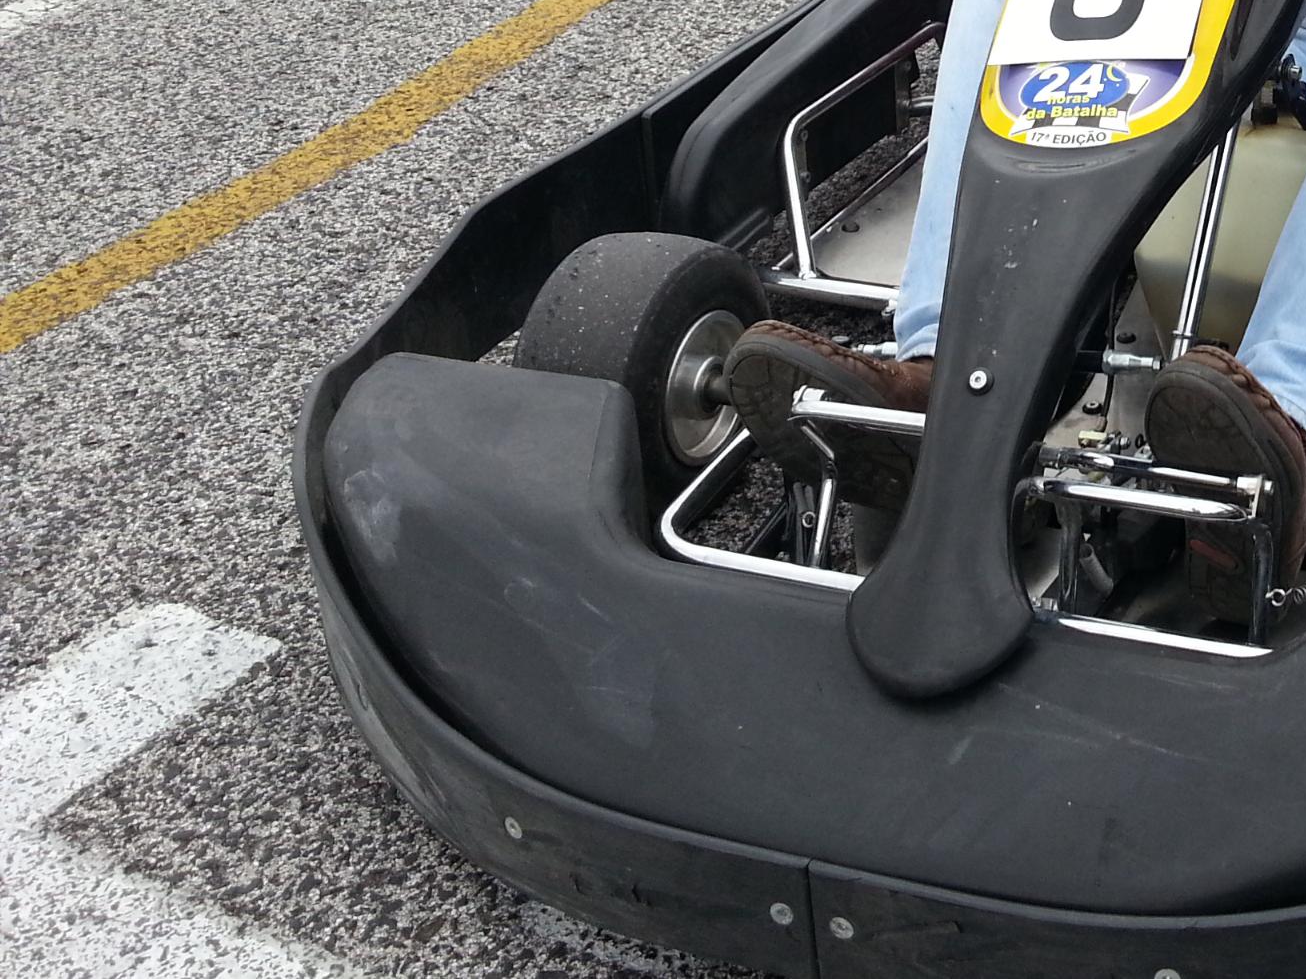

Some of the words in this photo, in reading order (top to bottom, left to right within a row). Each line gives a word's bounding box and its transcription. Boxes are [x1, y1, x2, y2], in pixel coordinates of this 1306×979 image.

[1032, 63, 1105, 102] 24
[1026, 107, 1047, 120] da
[1050, 104, 1119, 118] Batalha
[1053, 130, 1107, 146] EDIÇÃO
